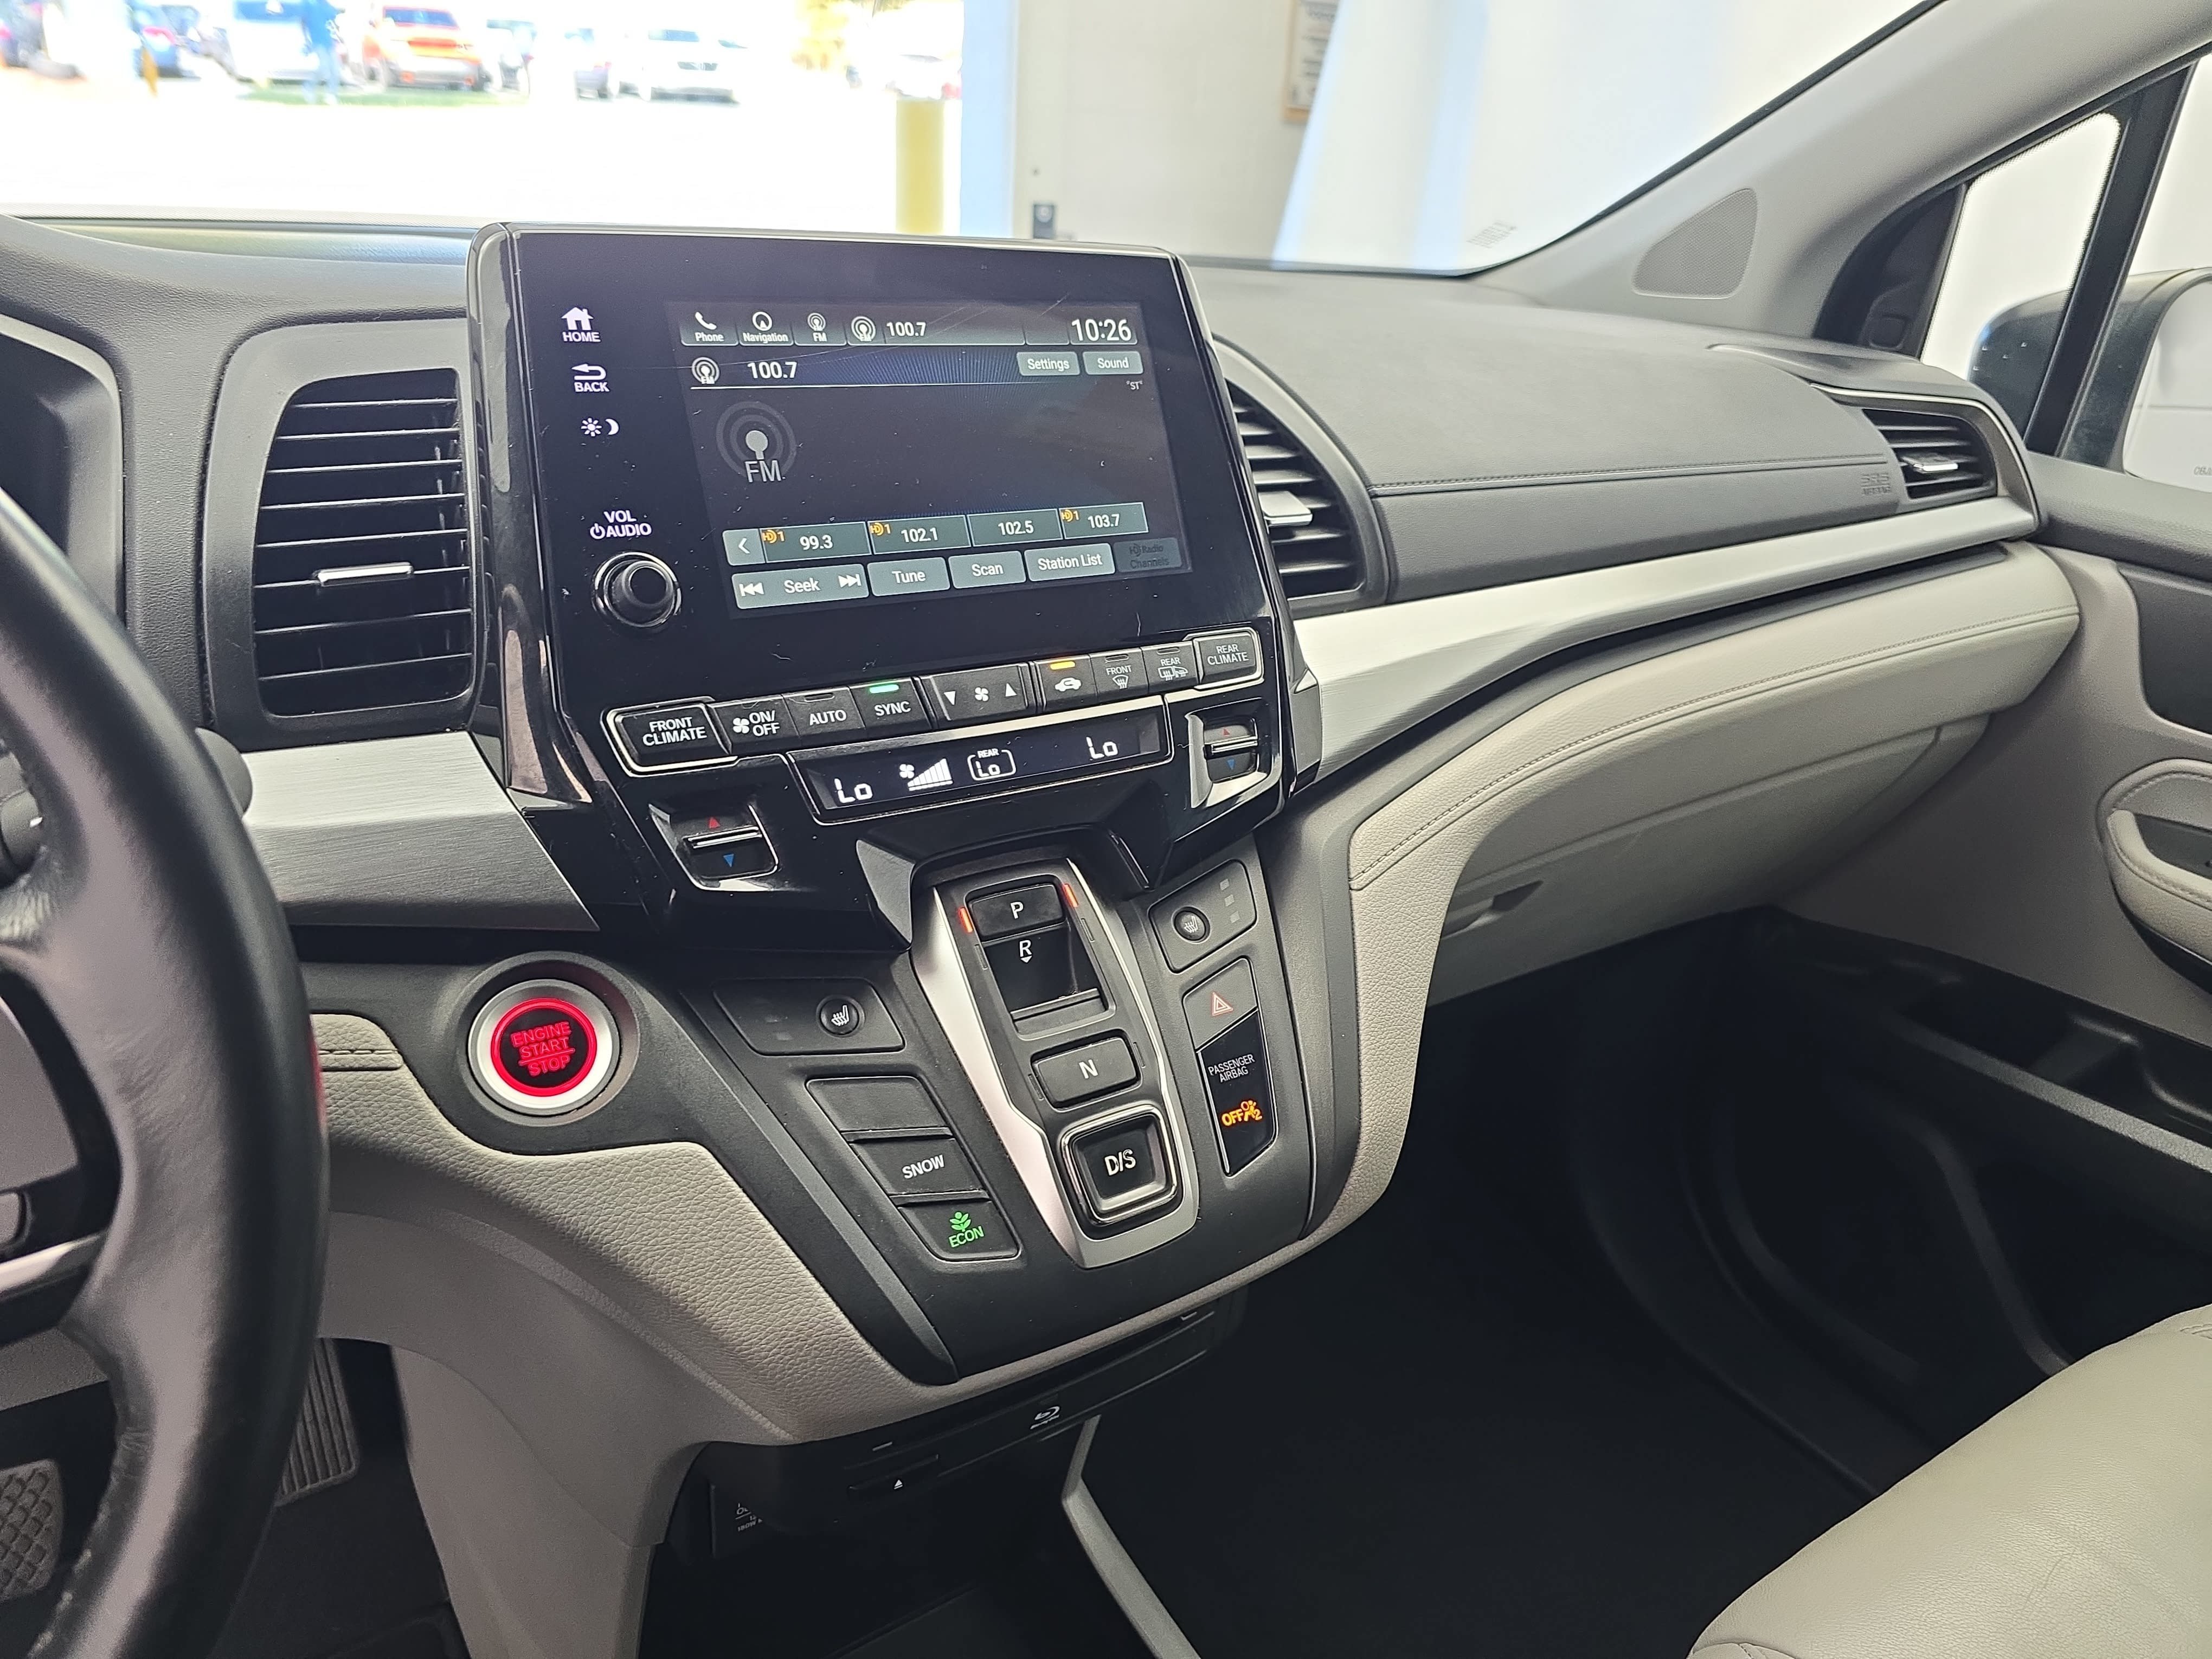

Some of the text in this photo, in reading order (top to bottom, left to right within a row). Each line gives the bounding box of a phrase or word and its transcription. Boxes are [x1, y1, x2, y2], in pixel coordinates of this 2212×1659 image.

[562, 331, 601, 343] HOME
[695, 331, 724, 342] Phone
[813, 332, 827, 342] FM
[886, 321, 927, 337] 100.7
[1071, 318, 1132, 342] 10:26
[742, 332, 789, 344] Navigation
[747, 362, 798, 378] 100.7
[1027, 358, 1070, 371] Settings
[1097, 356, 1129, 369] Sound
[574, 381, 610, 393] BACK
[745, 460, 782, 483] FM
[603, 510, 636, 523] VOL
[1088, 513, 1120, 529] 103.7
[606, 523, 652, 537] AUDIO
[901, 528, 938, 543] 102.1
[998, 520, 1034, 536] 102.5
[800, 534, 833, 550] 99.3
[1141, 544, 1164, 553] Radio
[972, 563, 1004, 577] Scan
[1037, 554, 1103, 571] Station List
[1130, 557, 1170, 569] Channels
[892, 570, 926, 584] Tune
[784, 577, 821, 594] Seek
[1216, 644, 1239, 654] REAR
[1160, 657, 1181, 666] REAR
[1207, 651, 1249, 665] CLIMATE
[1106, 664, 1132, 676] FRONT
[808, 709, 847, 725] AUTO
[874, 701, 911, 717] SYNC
[648, 716, 693, 732] FRONT
[749, 710, 776, 725] ON/
[642, 726, 708, 747] CLIMATE
[752, 722, 780, 737] OFF
[977, 748, 999, 758] REAR
[1086, 736, 1118, 760] Lo
[975, 760, 1001, 777] Lo
[834, 777, 873, 803] Lo
[1010, 901, 1024, 919] P
[1019, 940, 1032, 957] R
[510, 1021, 572, 1047] ENGINE
[519, 1037, 569, 1058] START
[528, 1054, 571, 1077] STOP
[1079, 1060, 1098, 1079] N
[1207, 1054, 1256, 1076] PASSENGER
[1219, 1066, 1249, 1083] AIRBAG
[1221, 1108, 1244, 1127] OFF
[902, 1155, 946, 1179] SNOW
[1104, 1149, 1136, 1176] D/S
[949, 1226, 985, 1248] ECON
